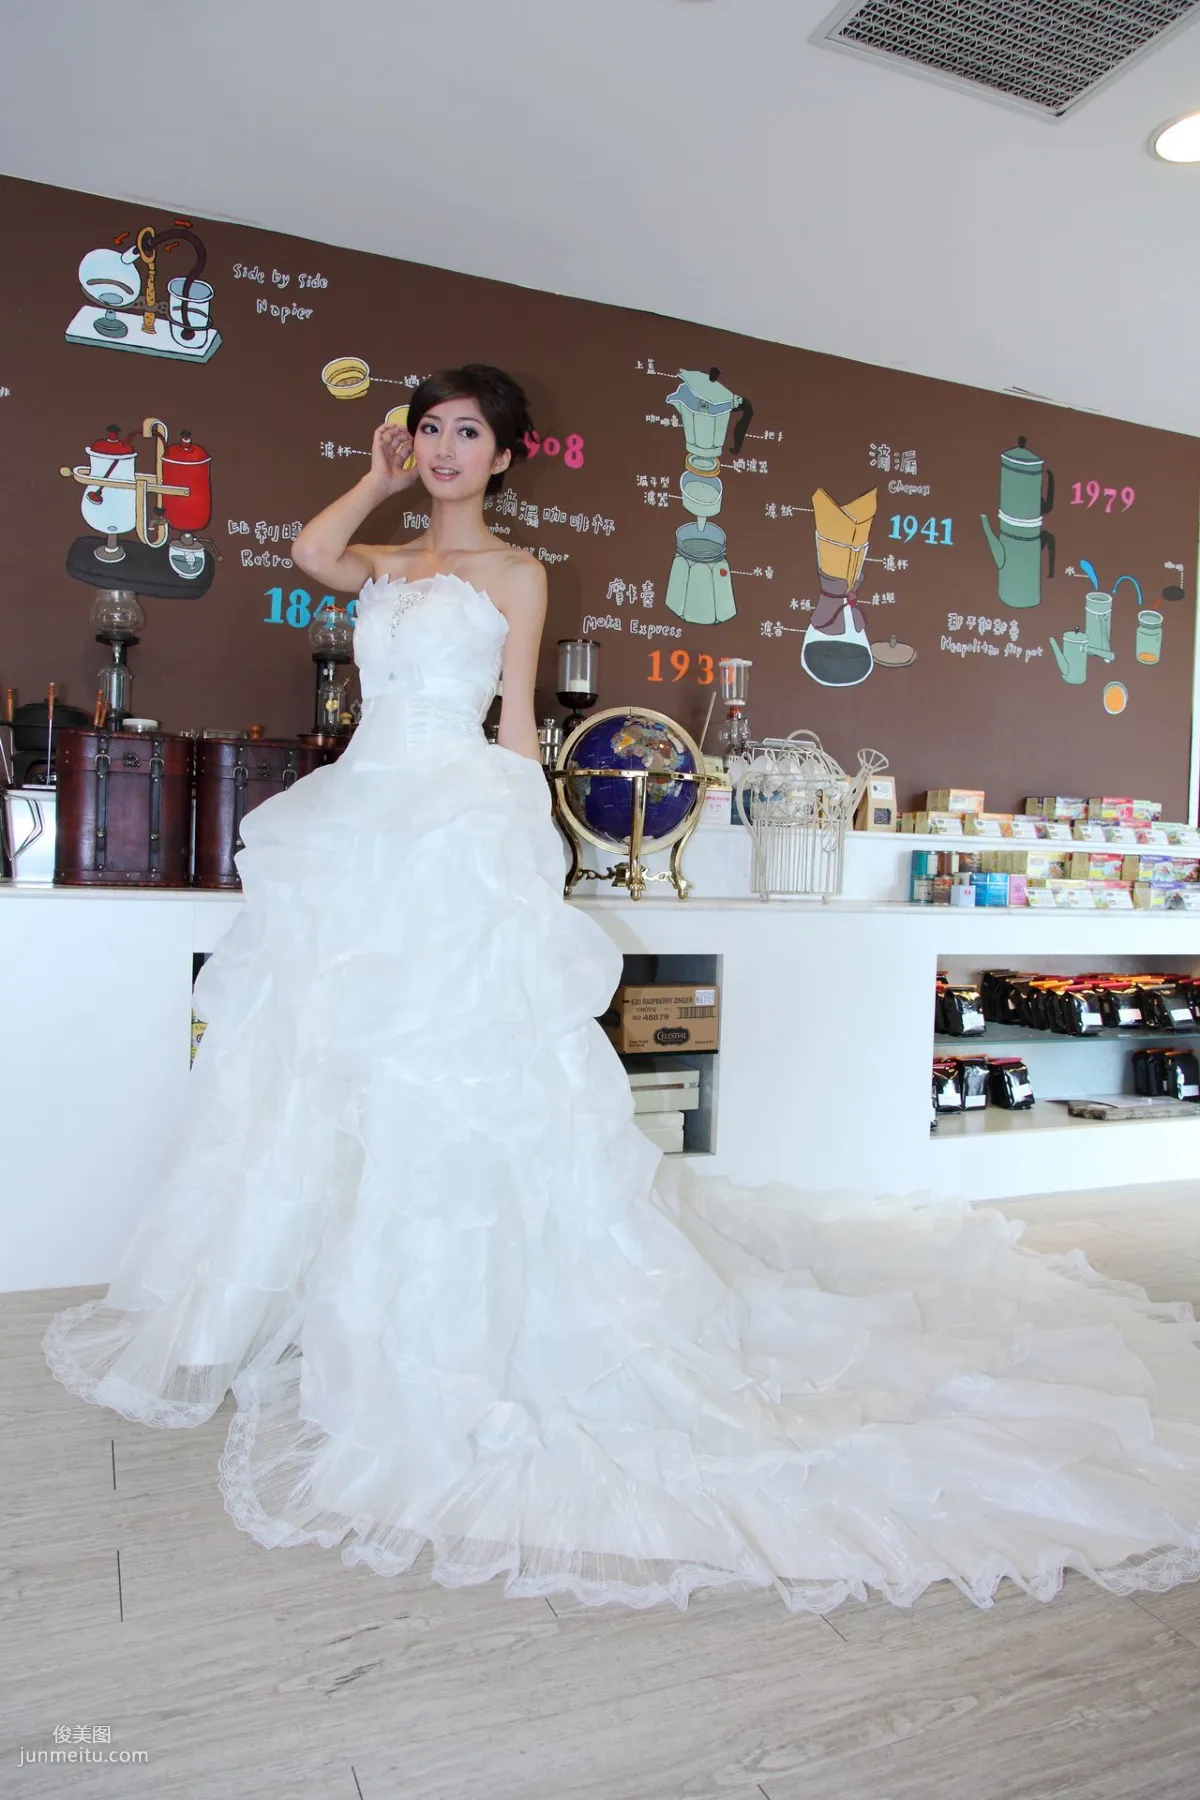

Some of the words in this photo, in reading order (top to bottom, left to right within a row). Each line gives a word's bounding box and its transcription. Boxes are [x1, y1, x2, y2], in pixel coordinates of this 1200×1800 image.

[233, 263, 265, 284] Side
[272, 268, 290, 289] by
[298, 272, 329, 289] Side
[869, 443, 917, 475] 滴漏
[888, 480, 931, 496] Chemex
[1070, 479, 1136, 513] 1979
[483, 488, 616, 536] 滴漏咖啡杯
[888, 514, 954, 546] 1941
[241, 549, 293, 569] Retro
[583, 615, 622, 634] Moka
[630, 619, 683, 640] Express
[642, 997, 673, 1005] RASPBERRY
[642, 1013, 670, 1021] 48879
